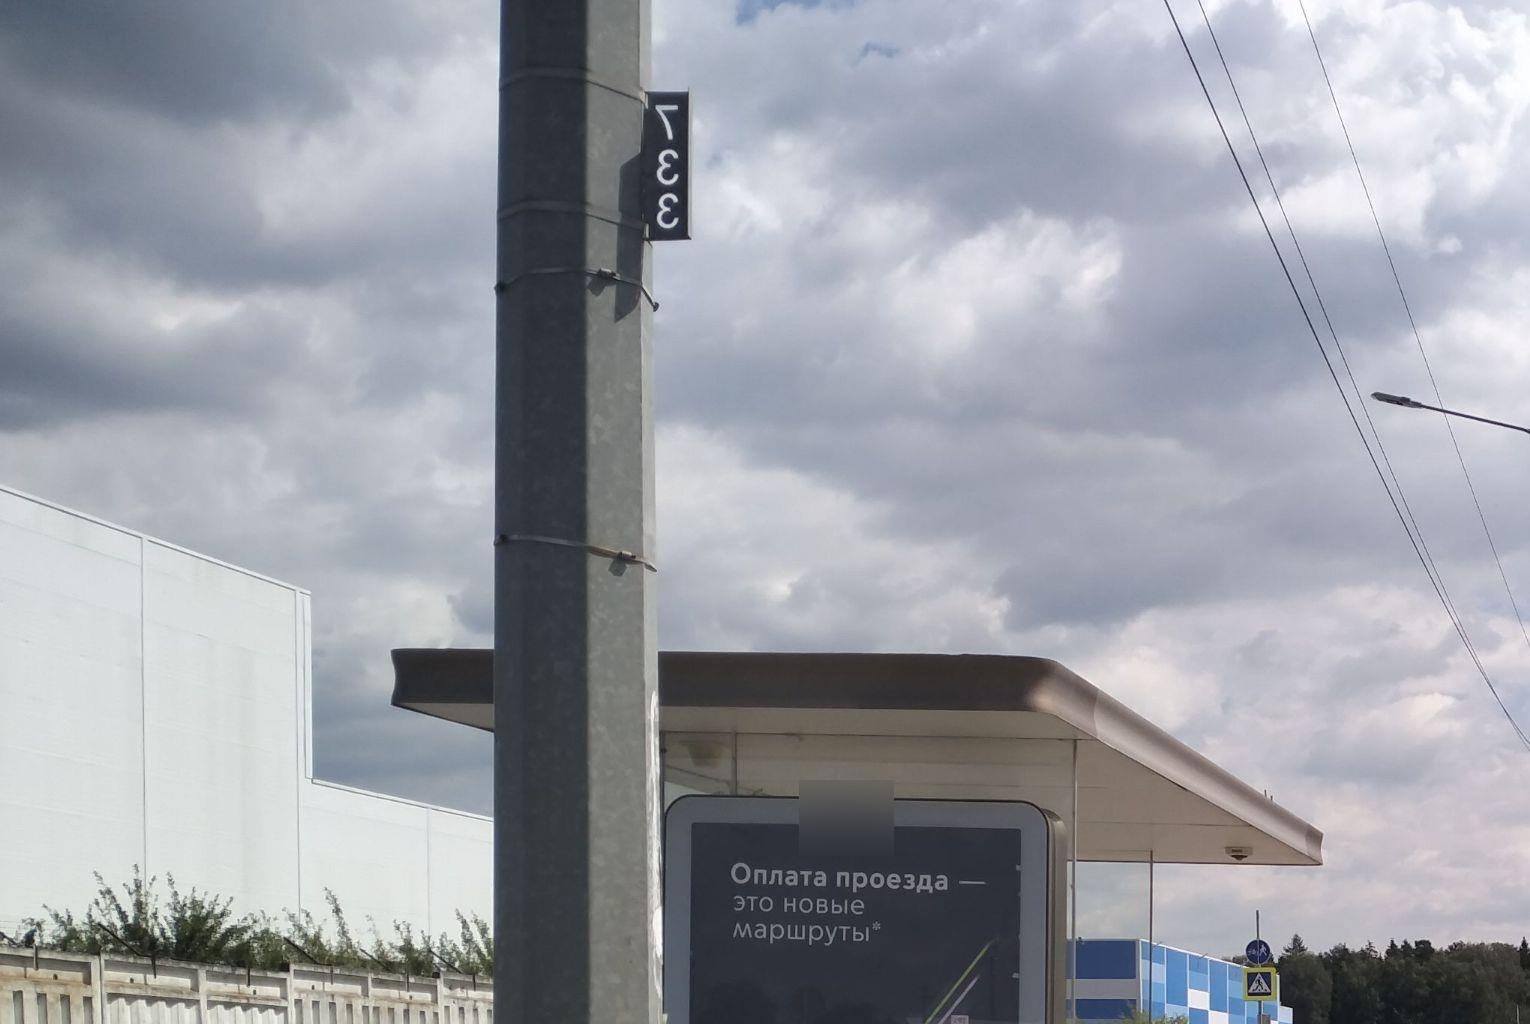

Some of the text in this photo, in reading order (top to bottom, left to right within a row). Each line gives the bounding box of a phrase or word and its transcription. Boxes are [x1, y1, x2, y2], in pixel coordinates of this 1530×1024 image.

[730, 862, 827, 888] Оплата
[836, 870, 949, 893] проезда
[732, 895, 865, 915] это новые
